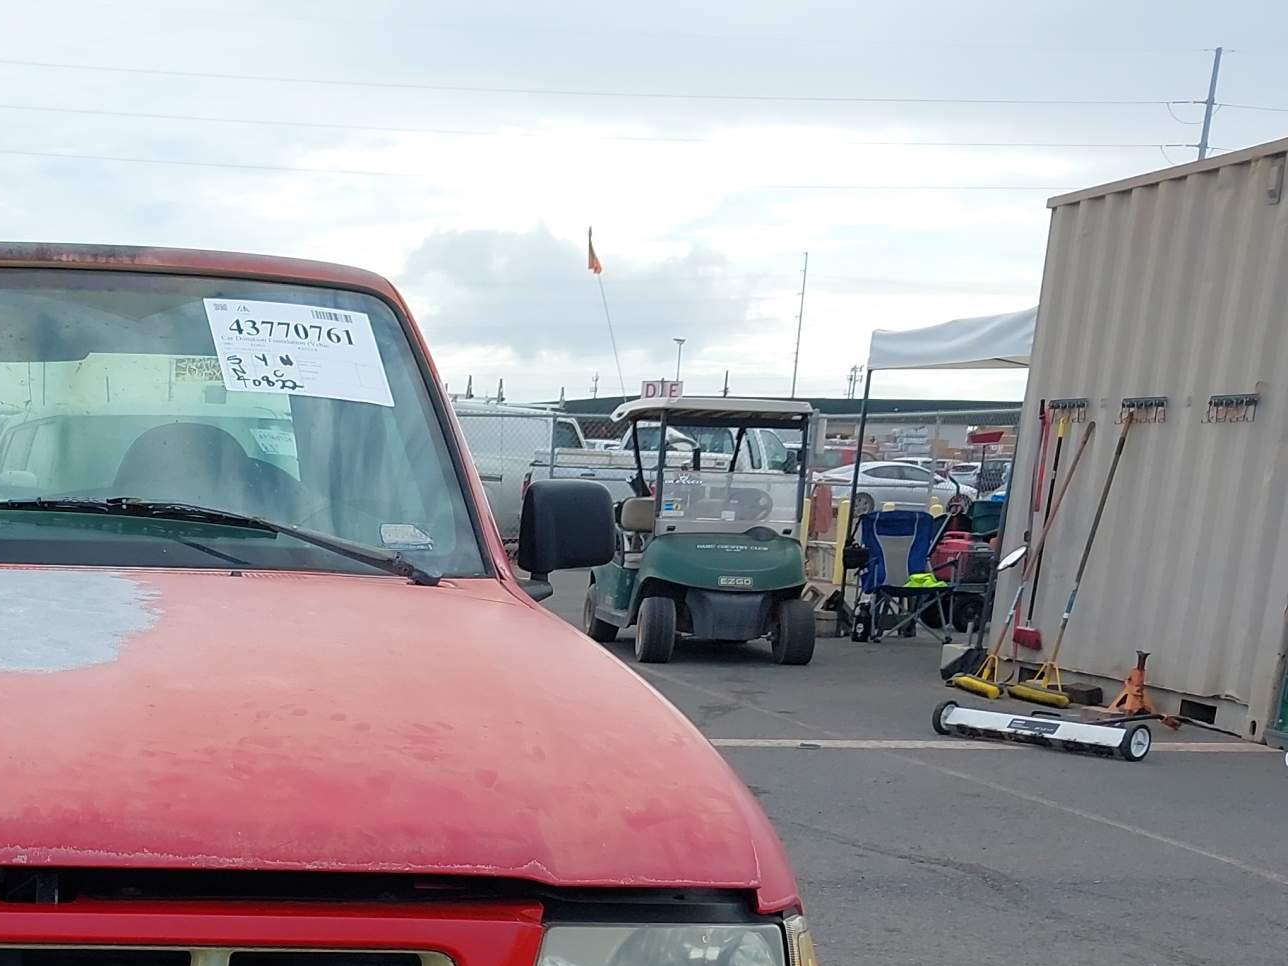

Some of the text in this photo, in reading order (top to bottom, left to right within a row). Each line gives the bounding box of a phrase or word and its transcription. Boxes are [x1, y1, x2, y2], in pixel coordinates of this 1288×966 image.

[229, 318, 355, 346] 43770761
[645, 383, 657, 398] D
[669, 383, 679, 398] E
